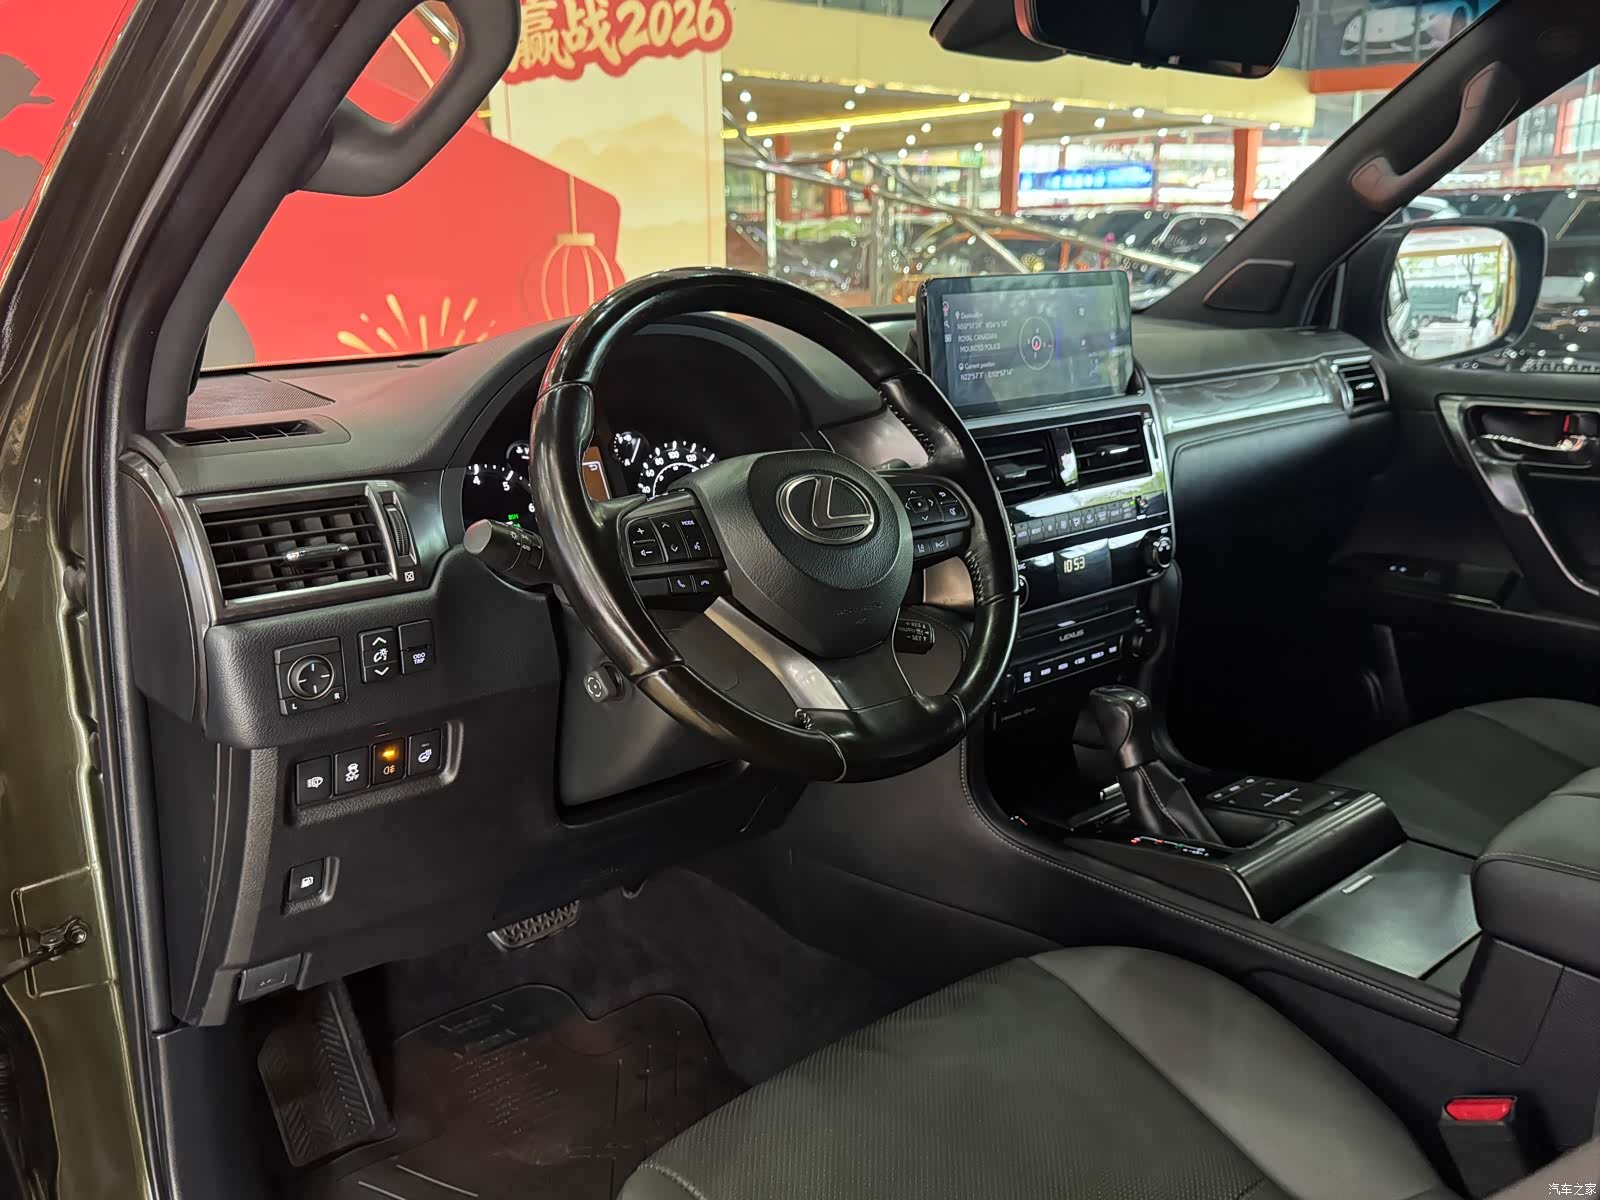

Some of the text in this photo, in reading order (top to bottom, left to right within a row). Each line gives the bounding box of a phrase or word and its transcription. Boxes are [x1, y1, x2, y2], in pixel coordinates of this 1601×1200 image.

[668, 451, 680, 459] 100
[686, 454, 697, 462] 120
[654, 457, 664, 466] 80
[645, 469, 655, 477] 60
[473, 475, 481, 486] 4
[502, 481, 510, 491] 5
[528, 503, 536, 512] 6
[1059, 629, 1085, 642] LEXUS
[413, 652, 426, 660] ODO
[346, 774, 360, 783] OFF
